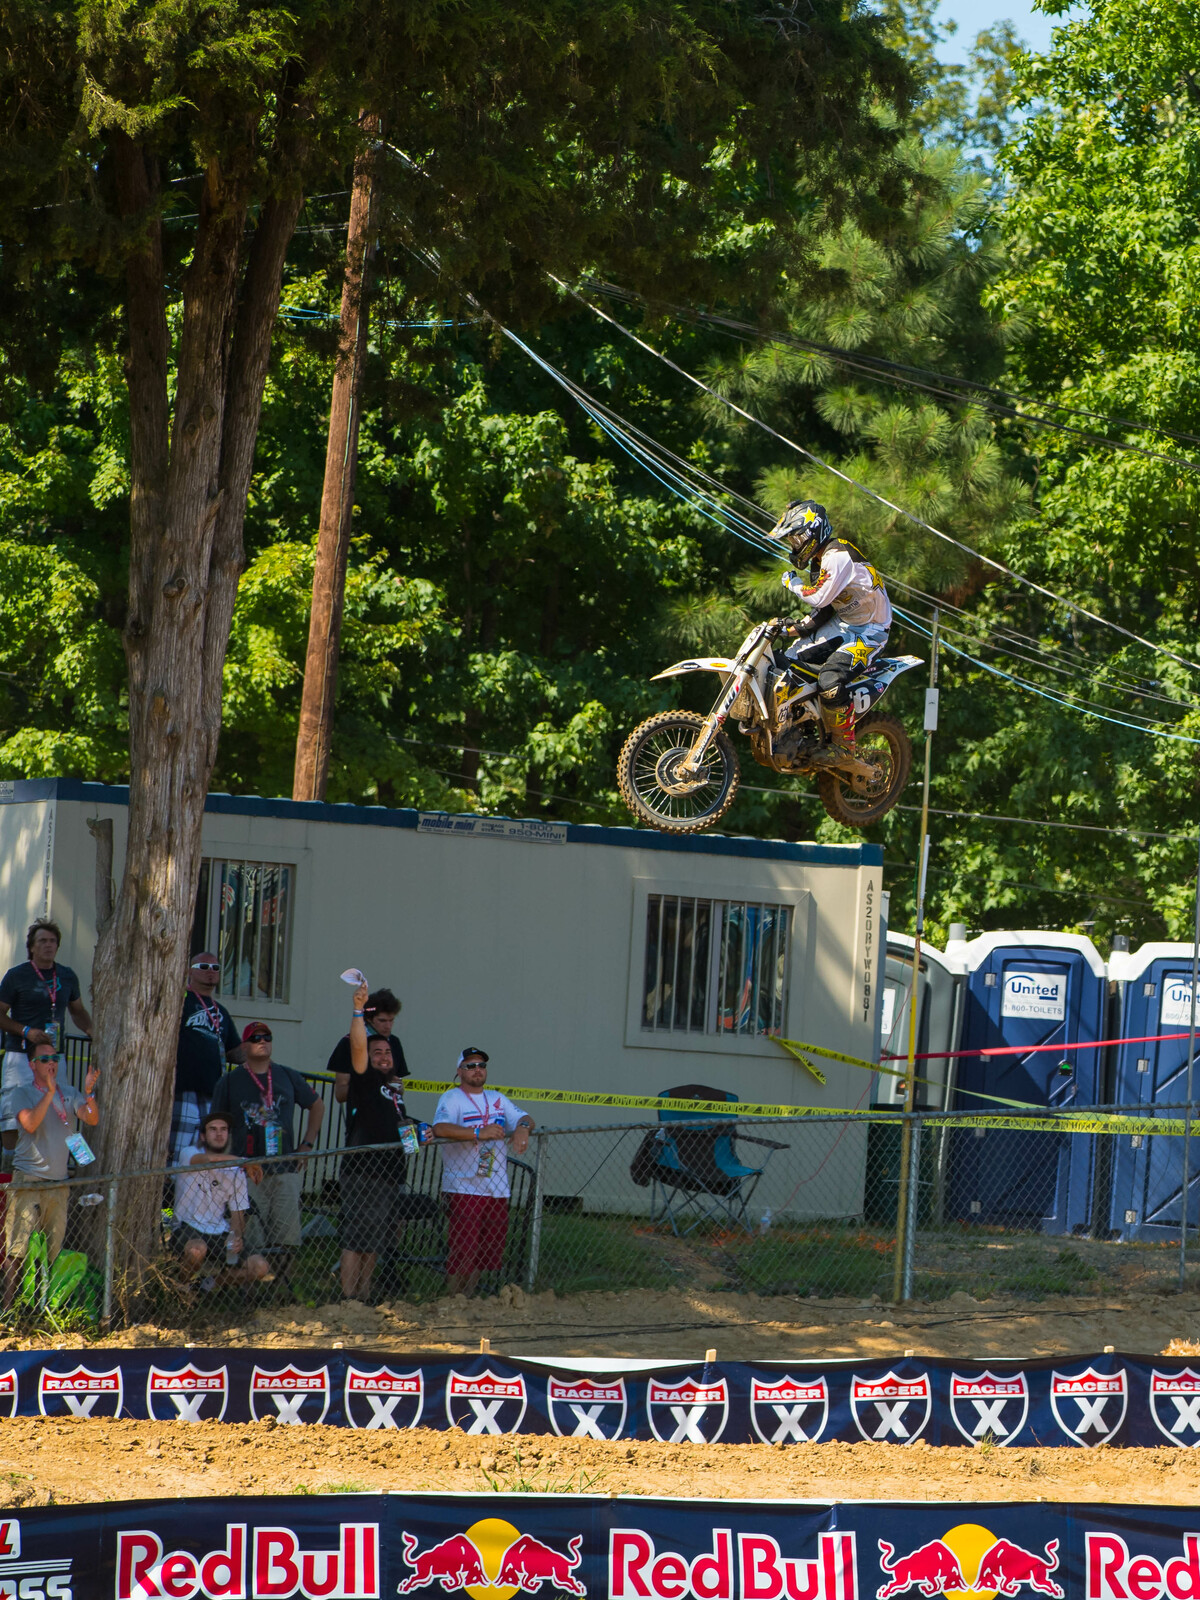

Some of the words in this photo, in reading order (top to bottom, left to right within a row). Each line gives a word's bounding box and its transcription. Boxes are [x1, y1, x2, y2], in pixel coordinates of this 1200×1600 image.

[422, 815, 453, 829] mobile
[454, 819, 477, 831] mini
[509, 828, 562, 839] 950-MINI
[1011, 981, 1059, 996] United
[46, 1379, 115, 1389] RACER
[154, 1377, 222, 1389] RACER
[256, 1377, 322, 1389] RACER
[352, 1379, 417, 1391] RACER
[454, 1382, 520, 1395] RACER
[857, 1385, 924, 1397] RACER
[956, 1383, 1021, 1395] RACER
[1056, 1381, 1120, 1393] RACER
[553, 1388, 619, 1400] RACER
[653, 1389, 721, 1402] RACER
[757, 1388, 822, 1400] RACER
[62, 1395, 100, 1418] X
[169, 1393, 207, 1422] X
[271, 1393, 308, 1425] X
[365, 1395, 403, 1429] X
[467, 1399, 504, 1435] X
[569, 1404, 608, 1441] X
[771, 1404, 809, 1442] X
[872, 1401, 910, 1439] X
[971, 1399, 1009, 1437] X
[1073, 1397, 1109, 1434] X
[669, 1406, 707, 1443] X
[117, 1524, 246, 1600] Red
[254, 1524, 379, 1600] Bull
[609, 1528, 733, 1600] Red
[738, 1531, 858, 1600] Bull
